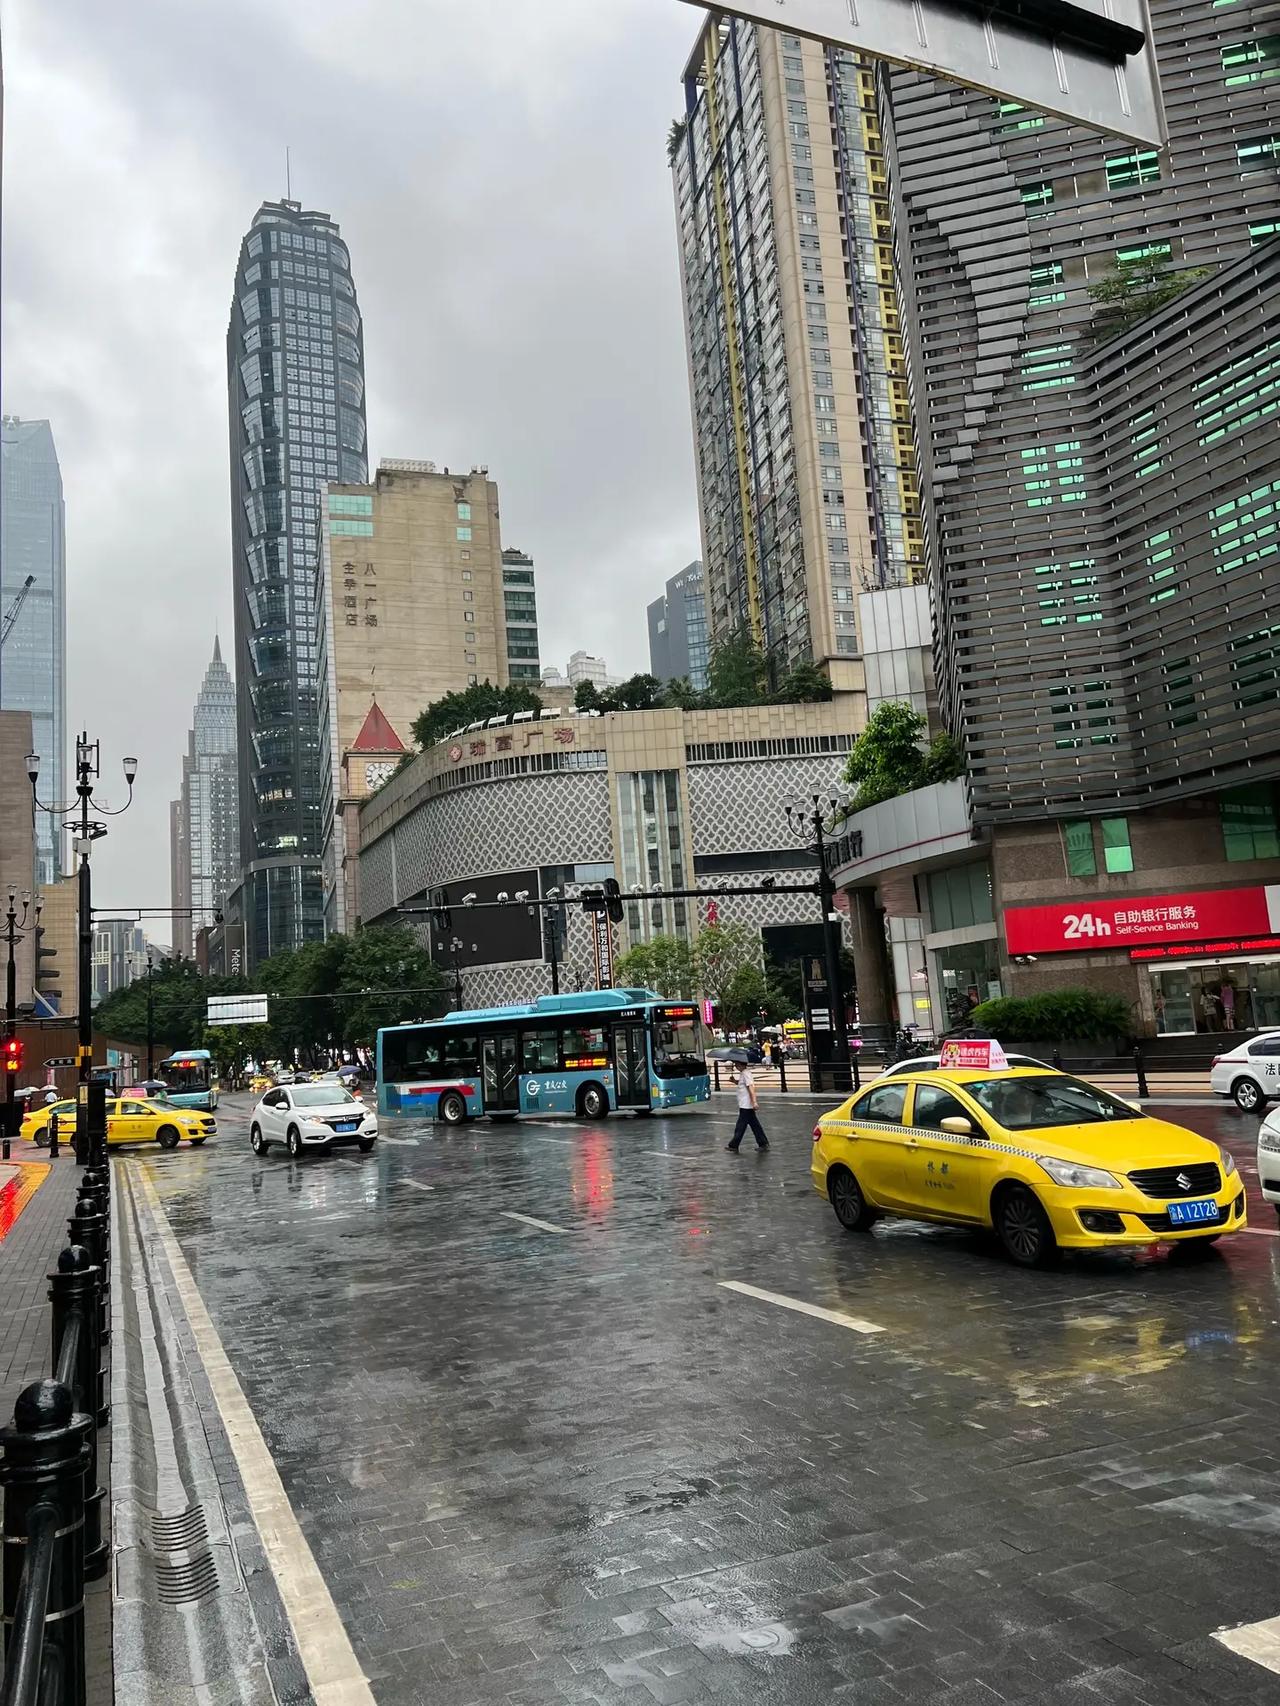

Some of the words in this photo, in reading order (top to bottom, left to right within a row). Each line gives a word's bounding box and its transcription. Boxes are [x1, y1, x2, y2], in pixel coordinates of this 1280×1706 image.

[342, 562, 358, 626] 全季酒店
[364, 563, 378, 627] 八一广场
[1062, 913, 1111, 939] 24h
[1114, 905, 1196, 925] 自助银行服务
[1116, 924, 1164, 935] Self-Service
[1165, 920, 1199, 931] Banking
[1265, 1063, 1280, 1076] 法
